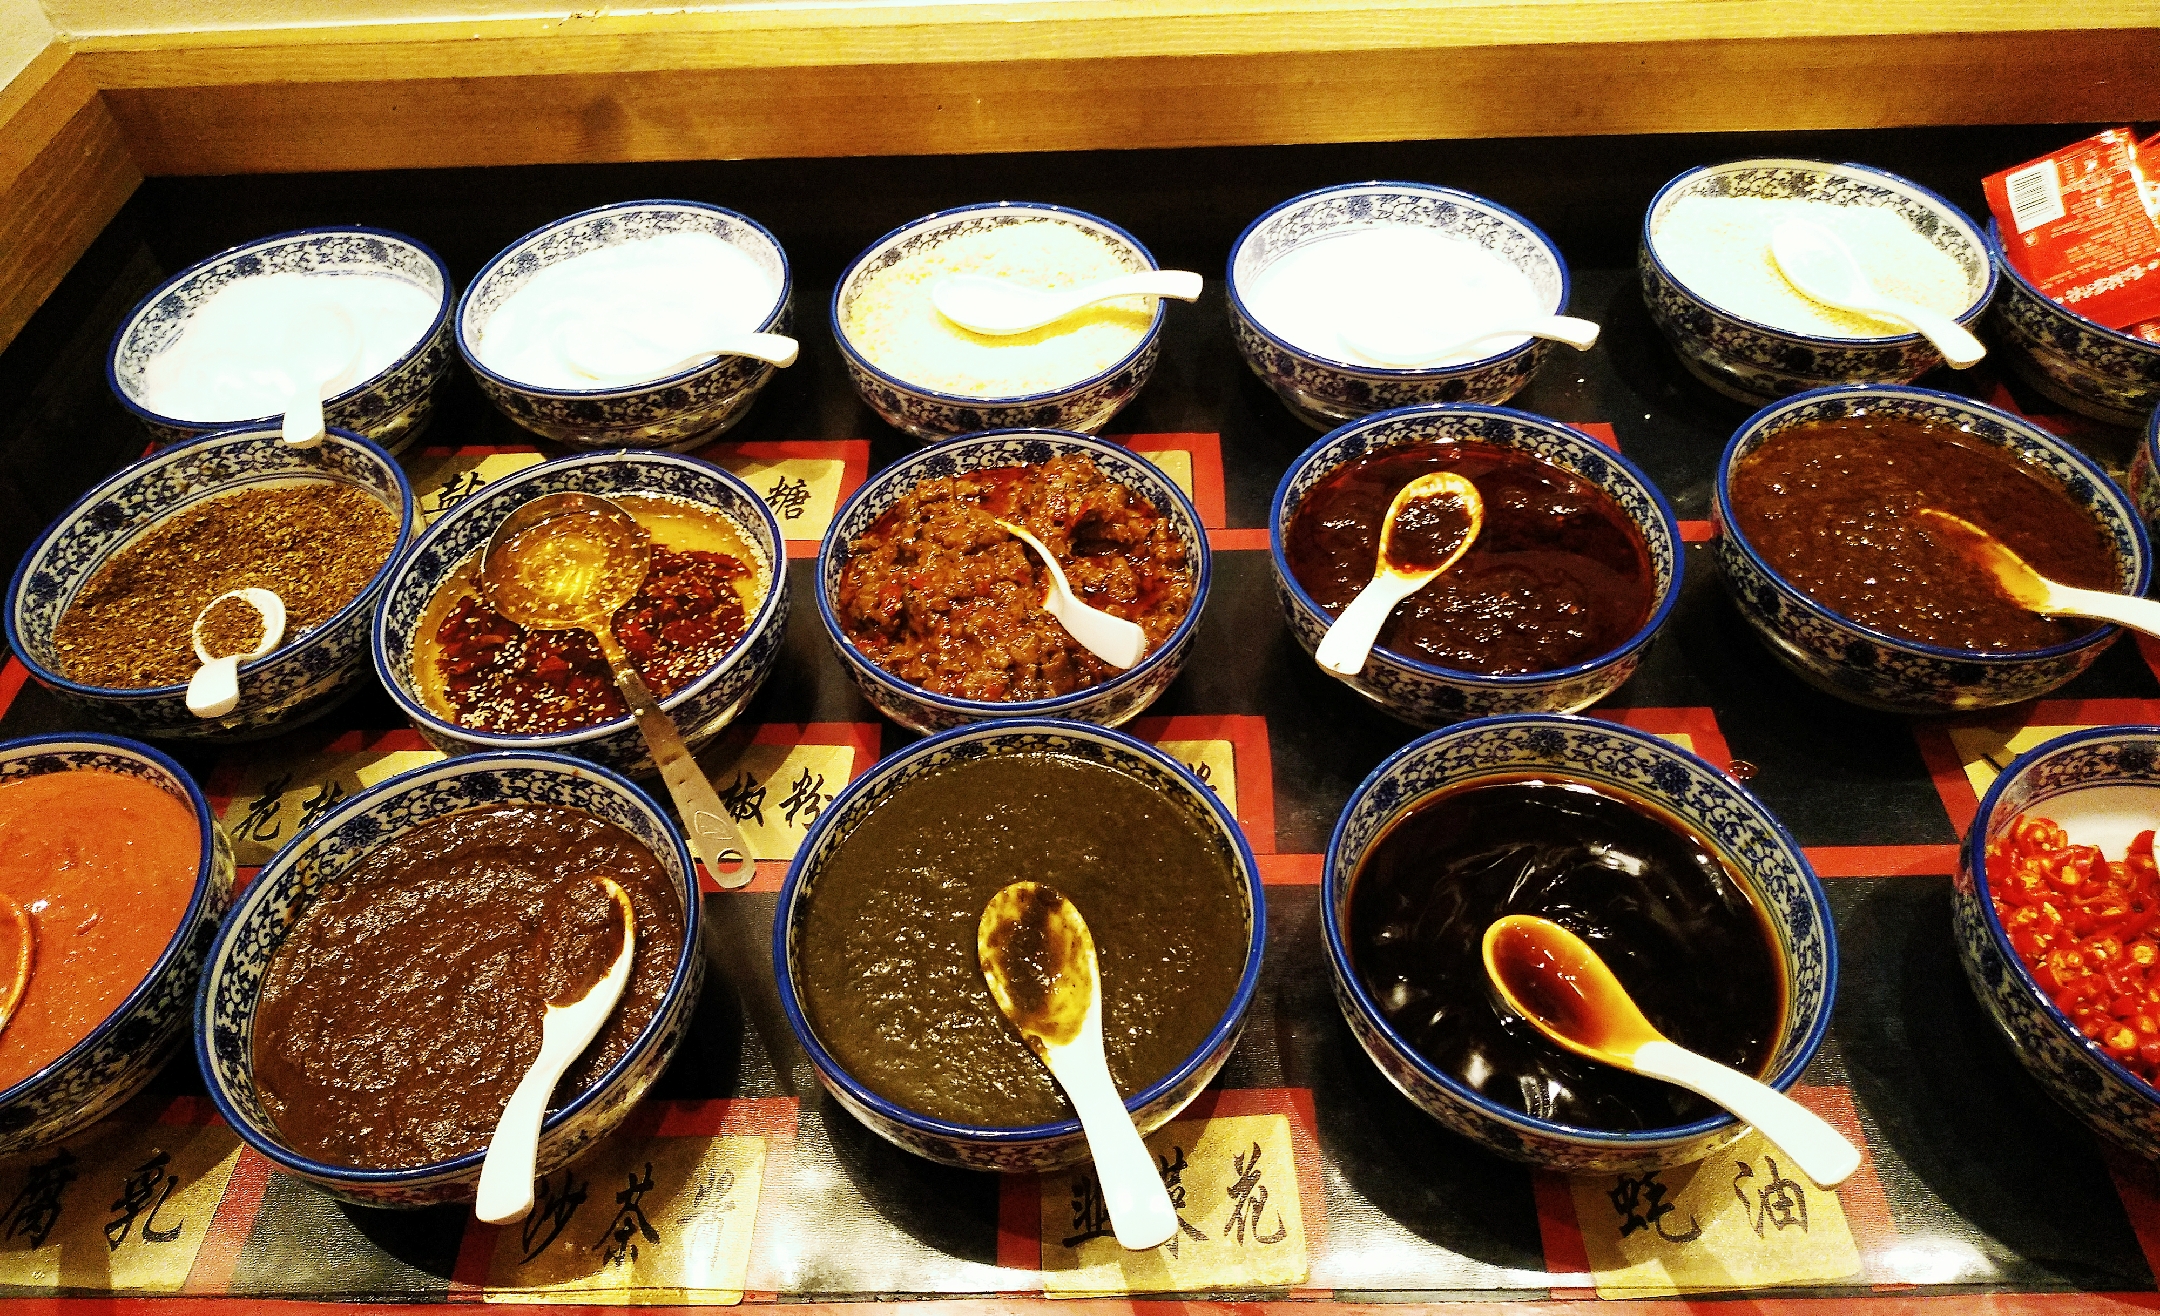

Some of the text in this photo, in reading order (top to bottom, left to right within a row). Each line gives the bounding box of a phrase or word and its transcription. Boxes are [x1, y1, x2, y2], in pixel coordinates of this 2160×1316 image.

[765, 475, 811, 520] 糖
[0, 1147, 186, 1251] 腐乳
[1606, 1155, 1809, 1243] 蚝油
